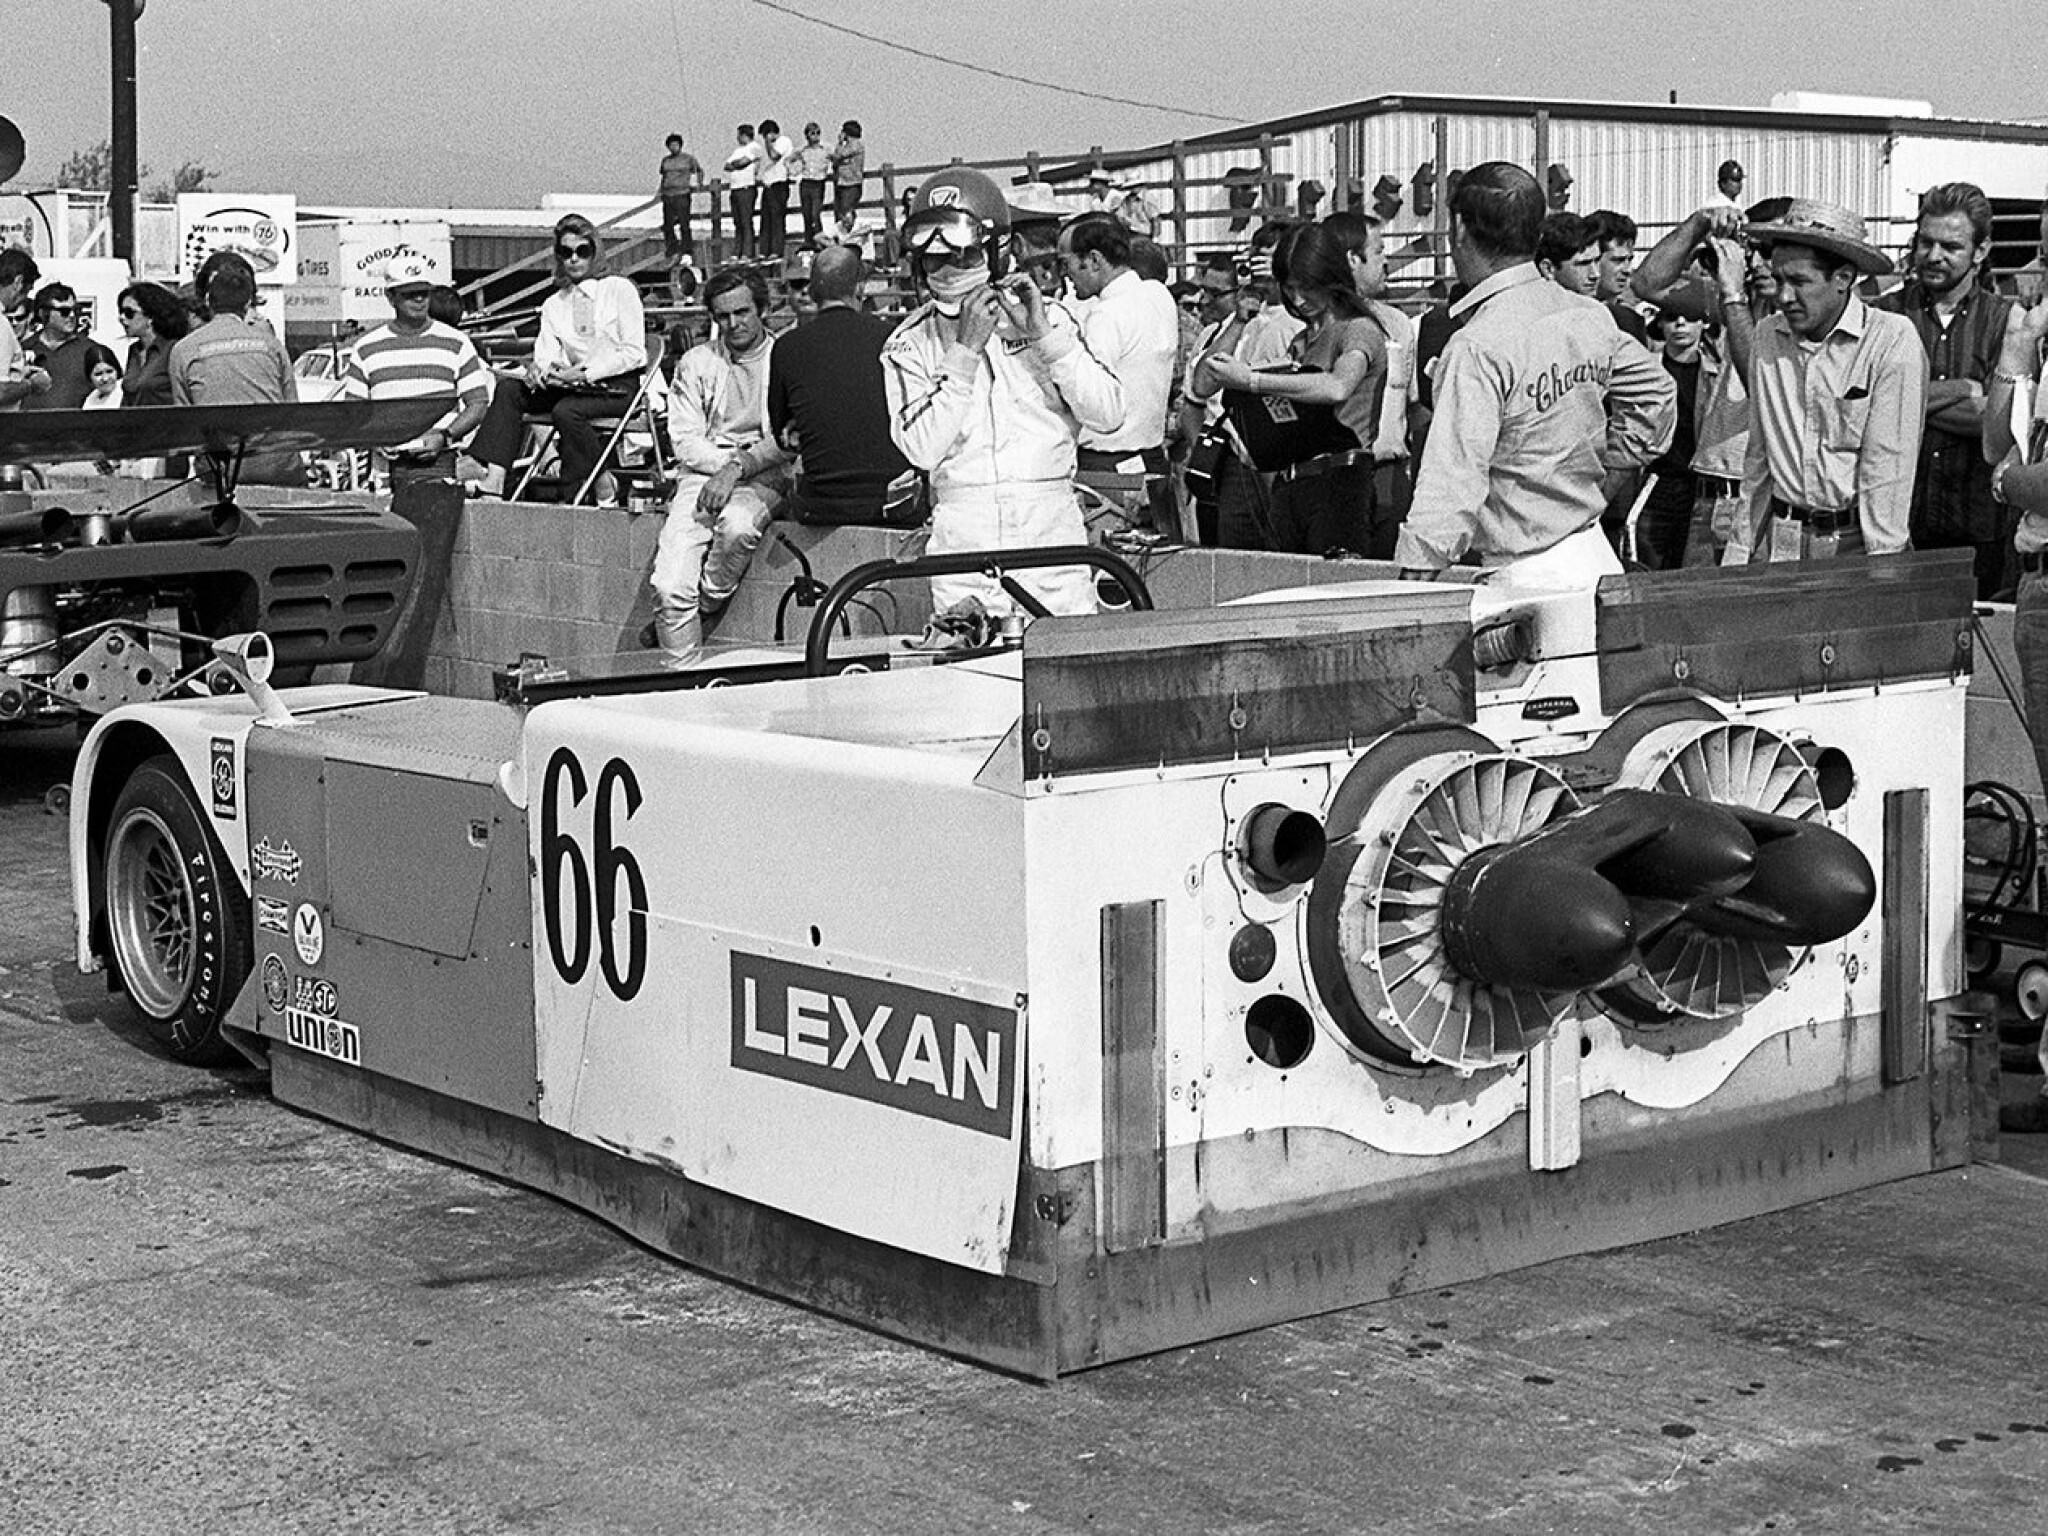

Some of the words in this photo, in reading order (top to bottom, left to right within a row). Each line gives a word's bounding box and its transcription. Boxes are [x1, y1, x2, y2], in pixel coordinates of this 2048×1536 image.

[192, 224, 219, 233] Win
[223, 224, 250, 233] with
[258, 226, 274, 239] 76
[192, 851, 215, 1014] Firestone
[541, 746, 649, 1000] 66
[315, 986, 335, 1012] STP
[744, 977, 1000, 1110] LEXAN
